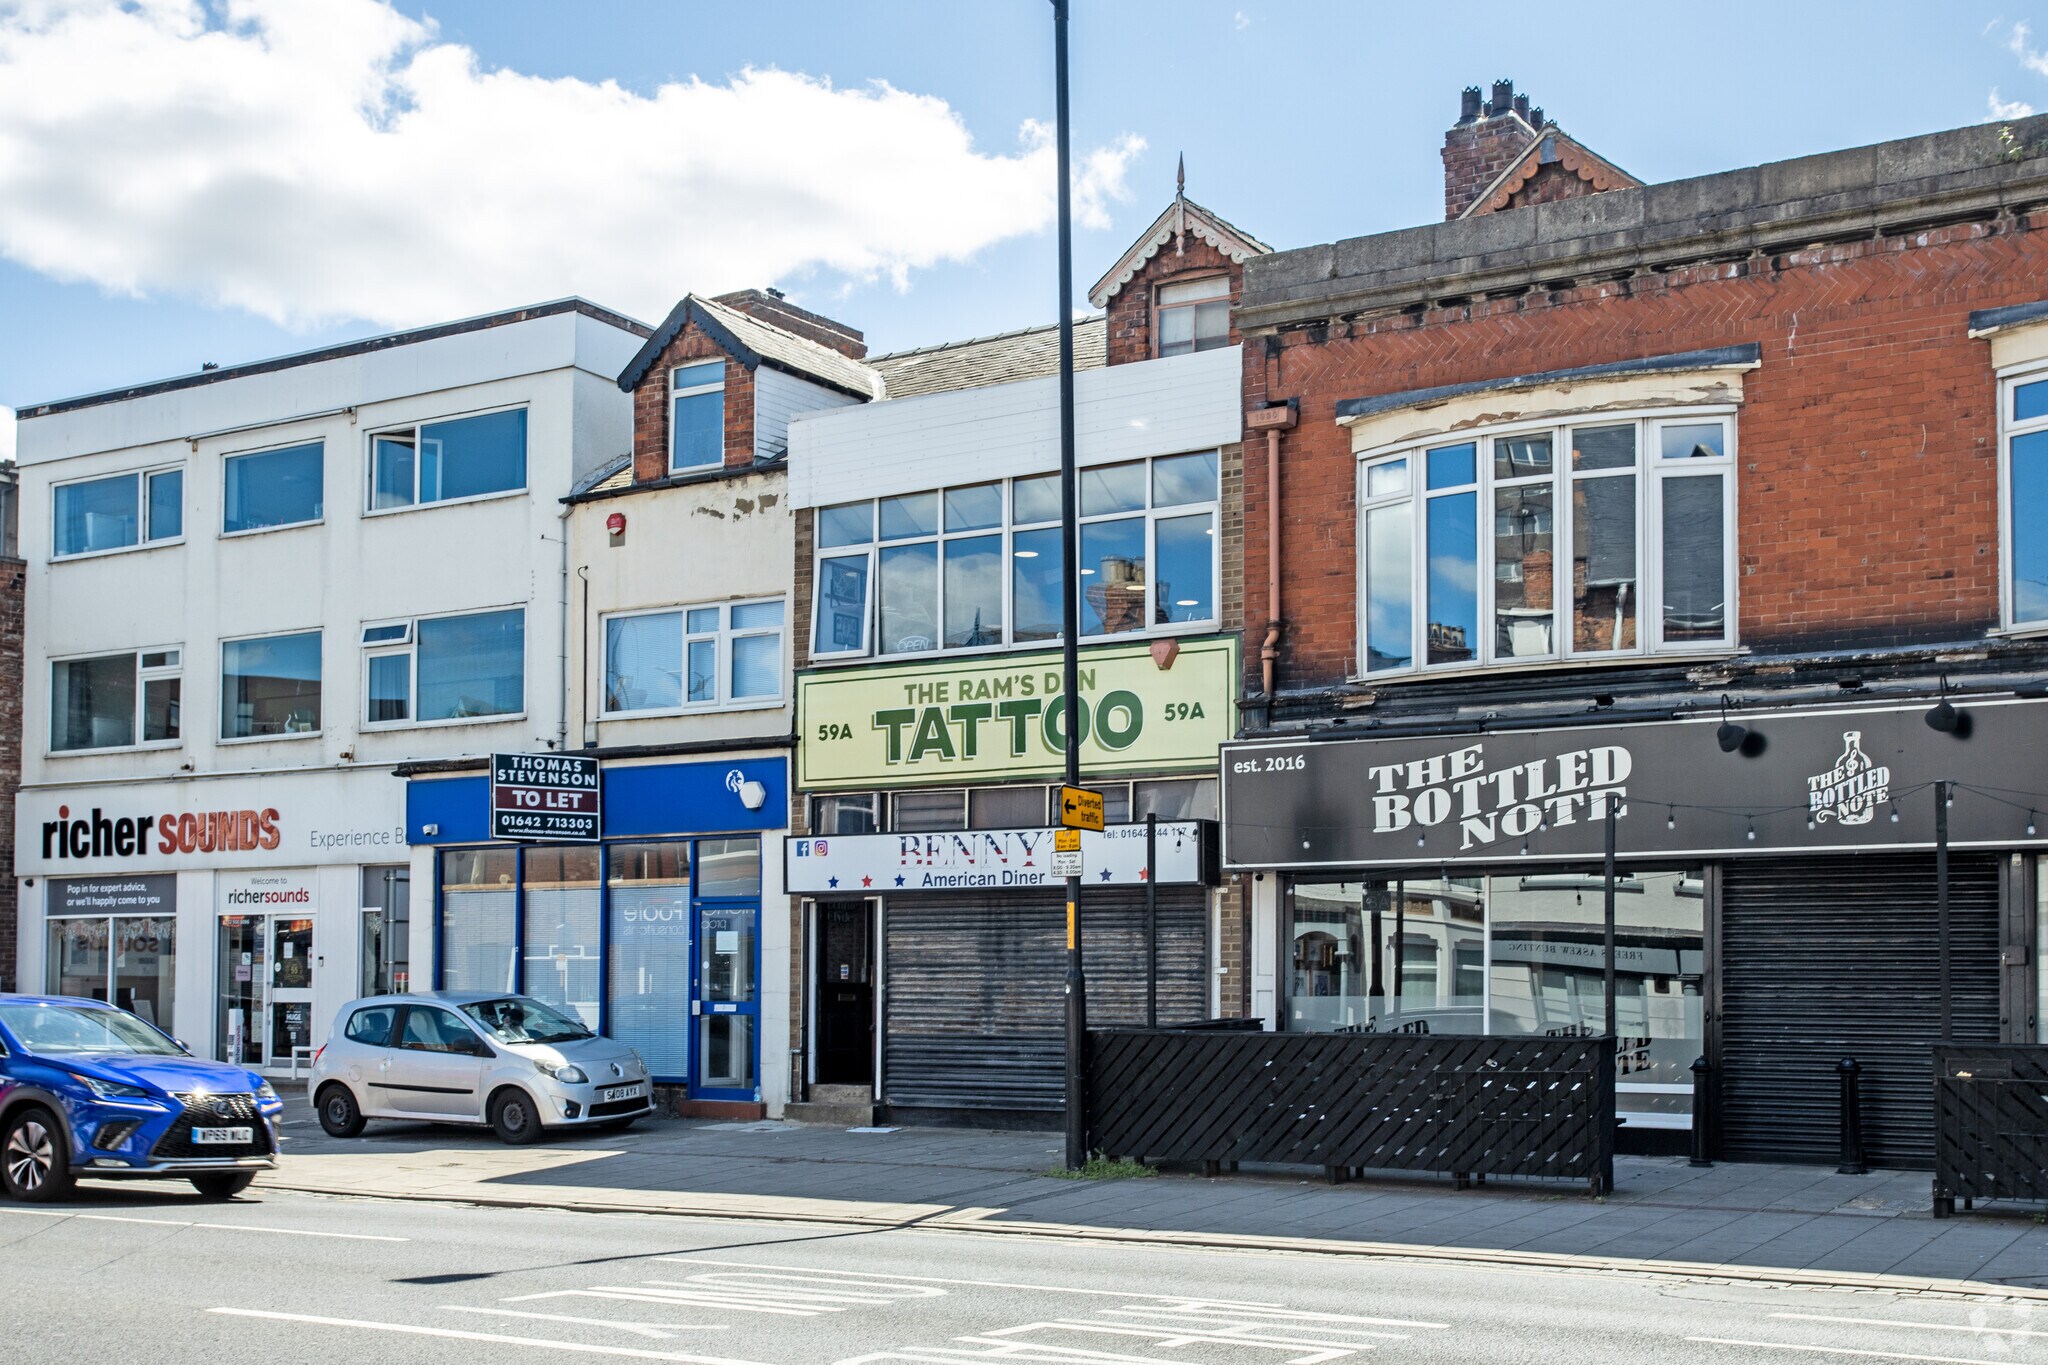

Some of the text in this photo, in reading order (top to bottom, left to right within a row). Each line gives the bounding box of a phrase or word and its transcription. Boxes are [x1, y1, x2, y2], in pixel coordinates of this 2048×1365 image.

[897, 638, 929, 650] OPEN
[904, 669, 1096, 704] THE RAM'S DN
[1164, 702, 1205, 722] 59A
[818, 724, 852, 741] 59A
[872, 689, 1144, 766] TATTOO
[511, 756, 582, 772] THOMAS
[1234, 755, 1306, 773] est. 2016
[1368, 744, 1484, 794] THE
[497, 768, 596, 786] STEVENSON
[1807, 765, 1845, 791] THE
[1372, 745, 1632, 833] BOTTLED
[1809, 766, 1890, 812] BOTTLED
[512, 789, 583, 809] TO LET
[1078, 795, 1101, 810] Diverted
[1837, 786, 1889, 820] NOTE
[501, 815, 593, 829] 01642 713303
[1081, 811, 1099, 824] traffic
[1459, 786, 1629, 850] NOTE
[42, 805, 280, 859] richer SOUNDS
[310, 826, 406, 850] Experience B
[1103, 830, 1118, 839] Tel:
[1121, 828, 1148, 839] 01642
[1155, 828, 1168, 837] 44
[897, 830, 1053, 870] BENNY'
[251, 877, 288, 886] Welcome to
[922, 870, 1045, 887] American Diner
[67, 882, 147, 895] Pop in for expert advice,
[228, 887, 310, 904] richersounds
[67, 898, 75, 906] or
[75, 897, 91, 906] we'll
[92, 897, 117, 907] happily
[138, 896, 146, 904] to
[146, 897, 161, 906] you
[1617, 1048, 1652, 1075] TE
